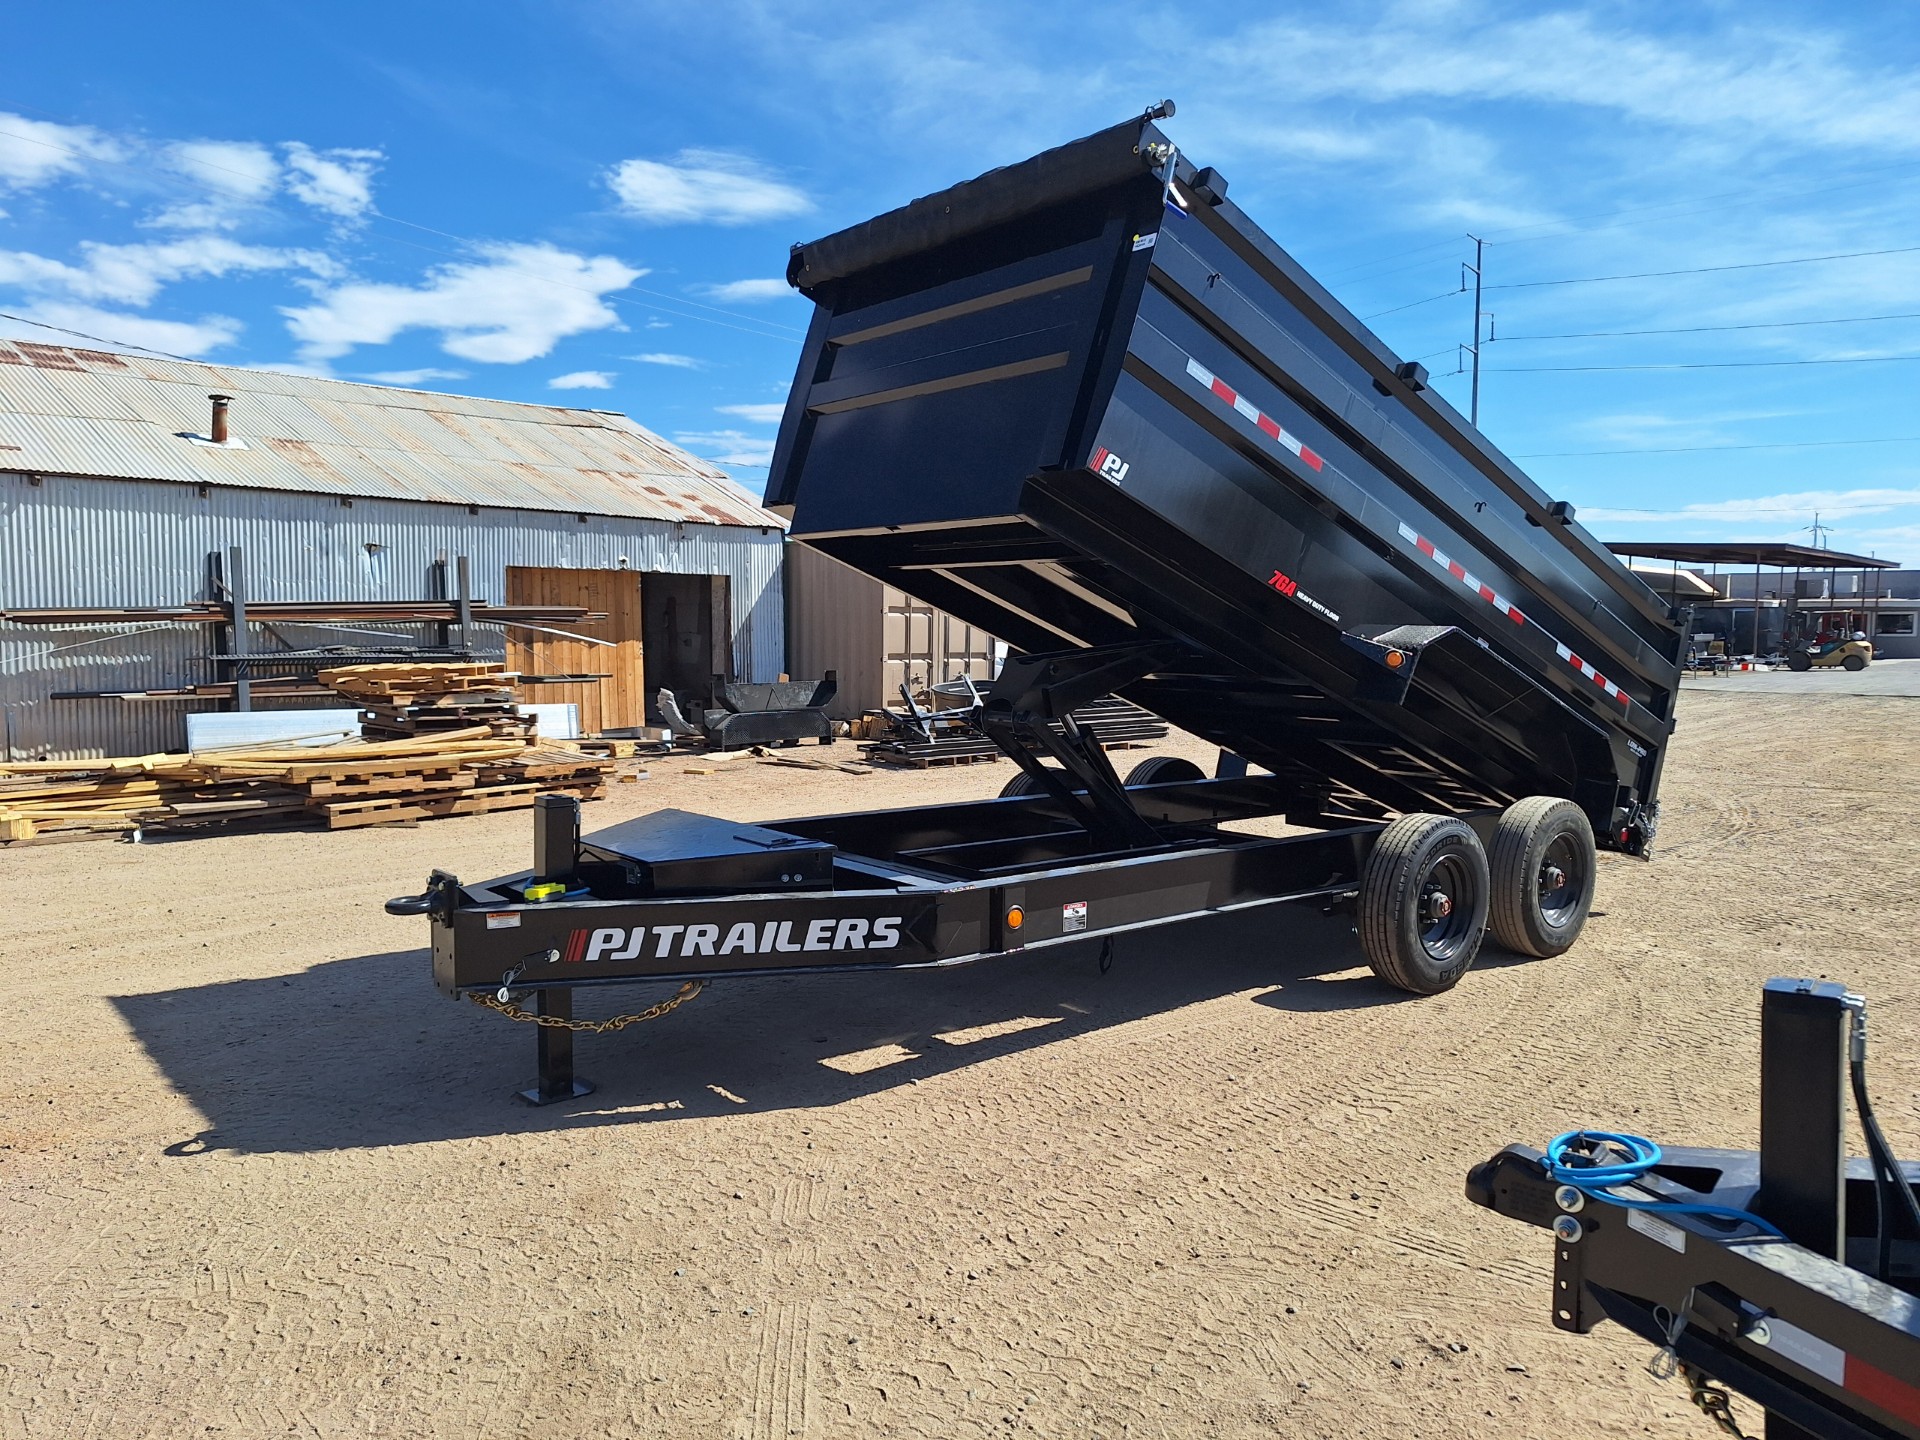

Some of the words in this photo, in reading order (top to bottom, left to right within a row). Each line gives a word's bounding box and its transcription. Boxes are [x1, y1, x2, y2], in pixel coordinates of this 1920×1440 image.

[1101, 452, 1130, 481] PJ
[1267, 569, 1297, 597] 7GA
[1296, 590, 1313, 605] HEAVY
[1311, 600, 1326, 613] DUTY
[585, 926, 646, 961] PJ
[652, 916, 902, 958] TRAILERS
